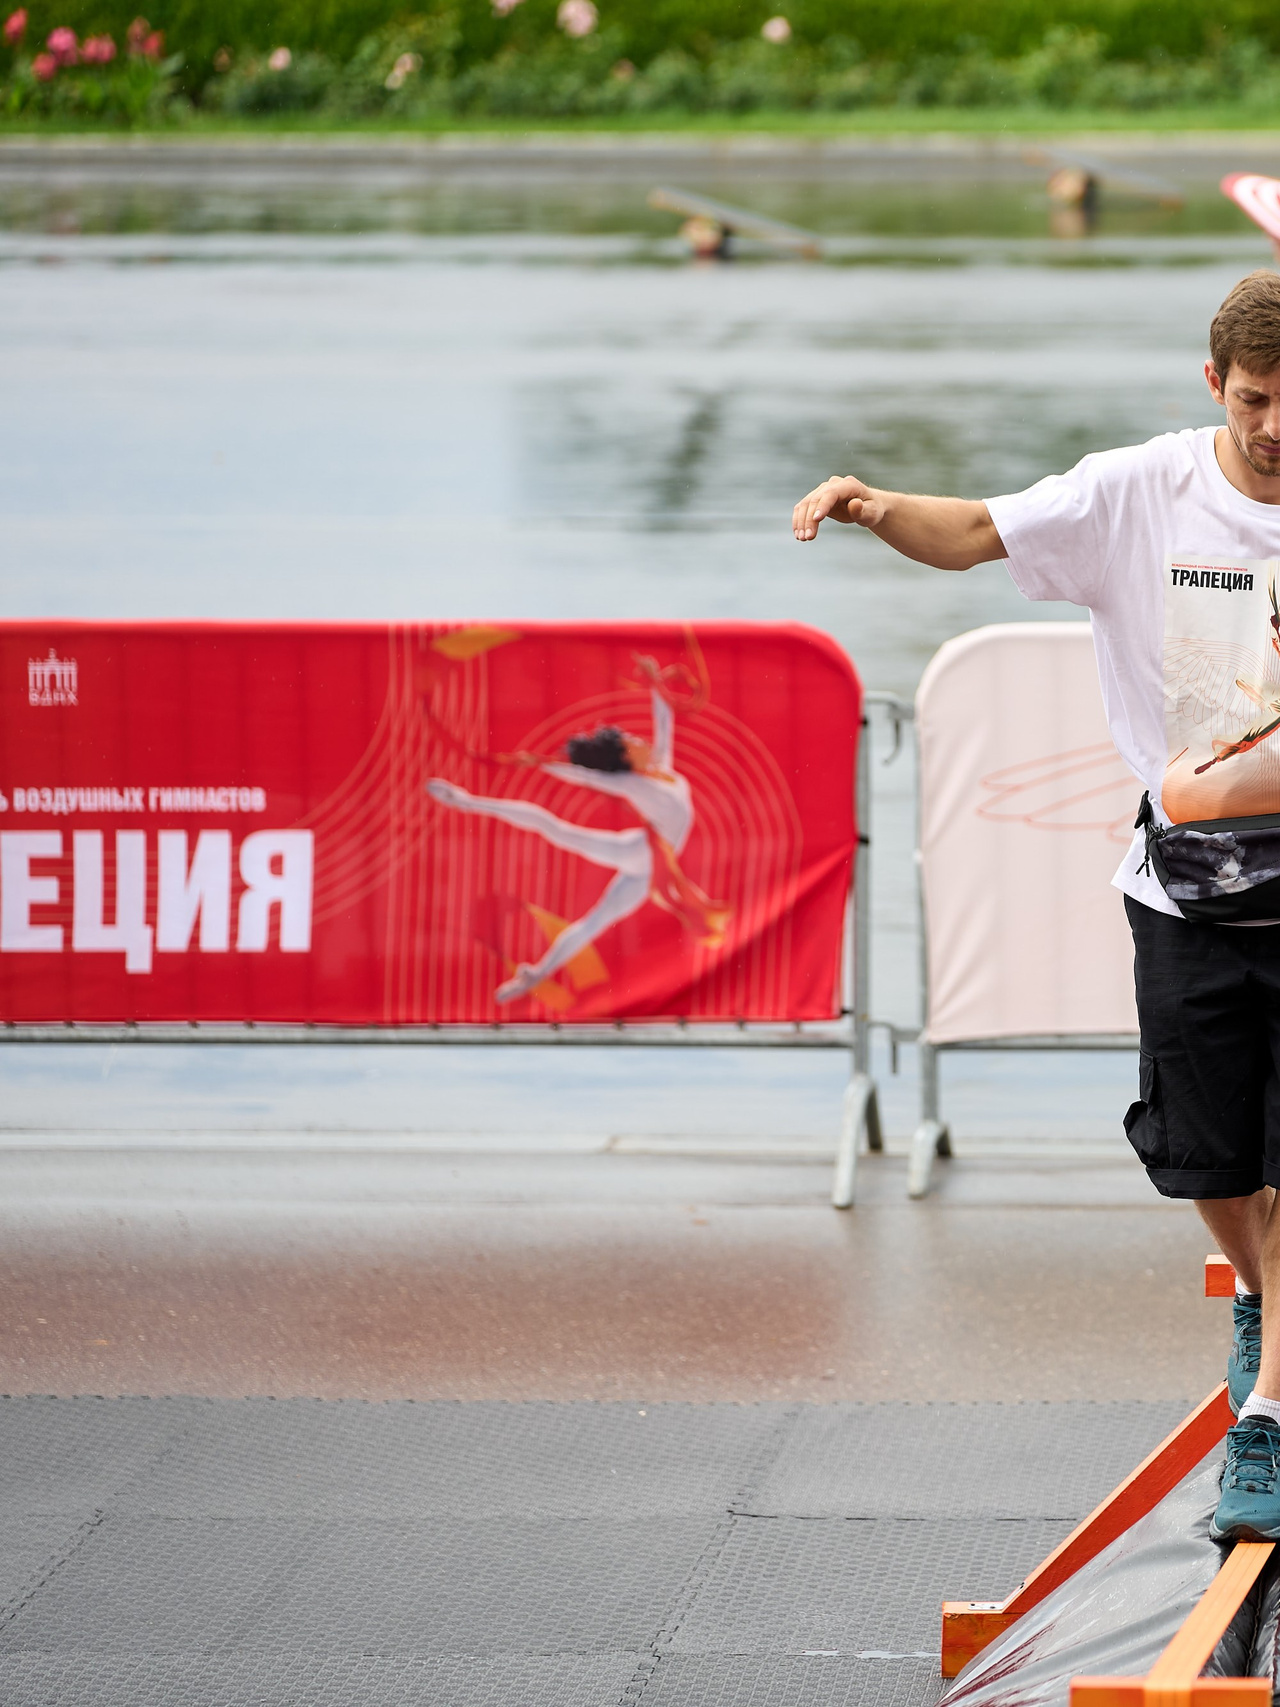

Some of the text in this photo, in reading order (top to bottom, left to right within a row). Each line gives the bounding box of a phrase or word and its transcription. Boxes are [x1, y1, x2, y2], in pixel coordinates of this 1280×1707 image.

[1171, 569, 1254, 592] ТРАПЕЦИЯ
[13, 787, 145, 815] ВОЗДУШНЫХ
[149, 787, 266, 812] ГИМНАСТОВ
[0, 829, 314, 974] ЕЦИЯ
